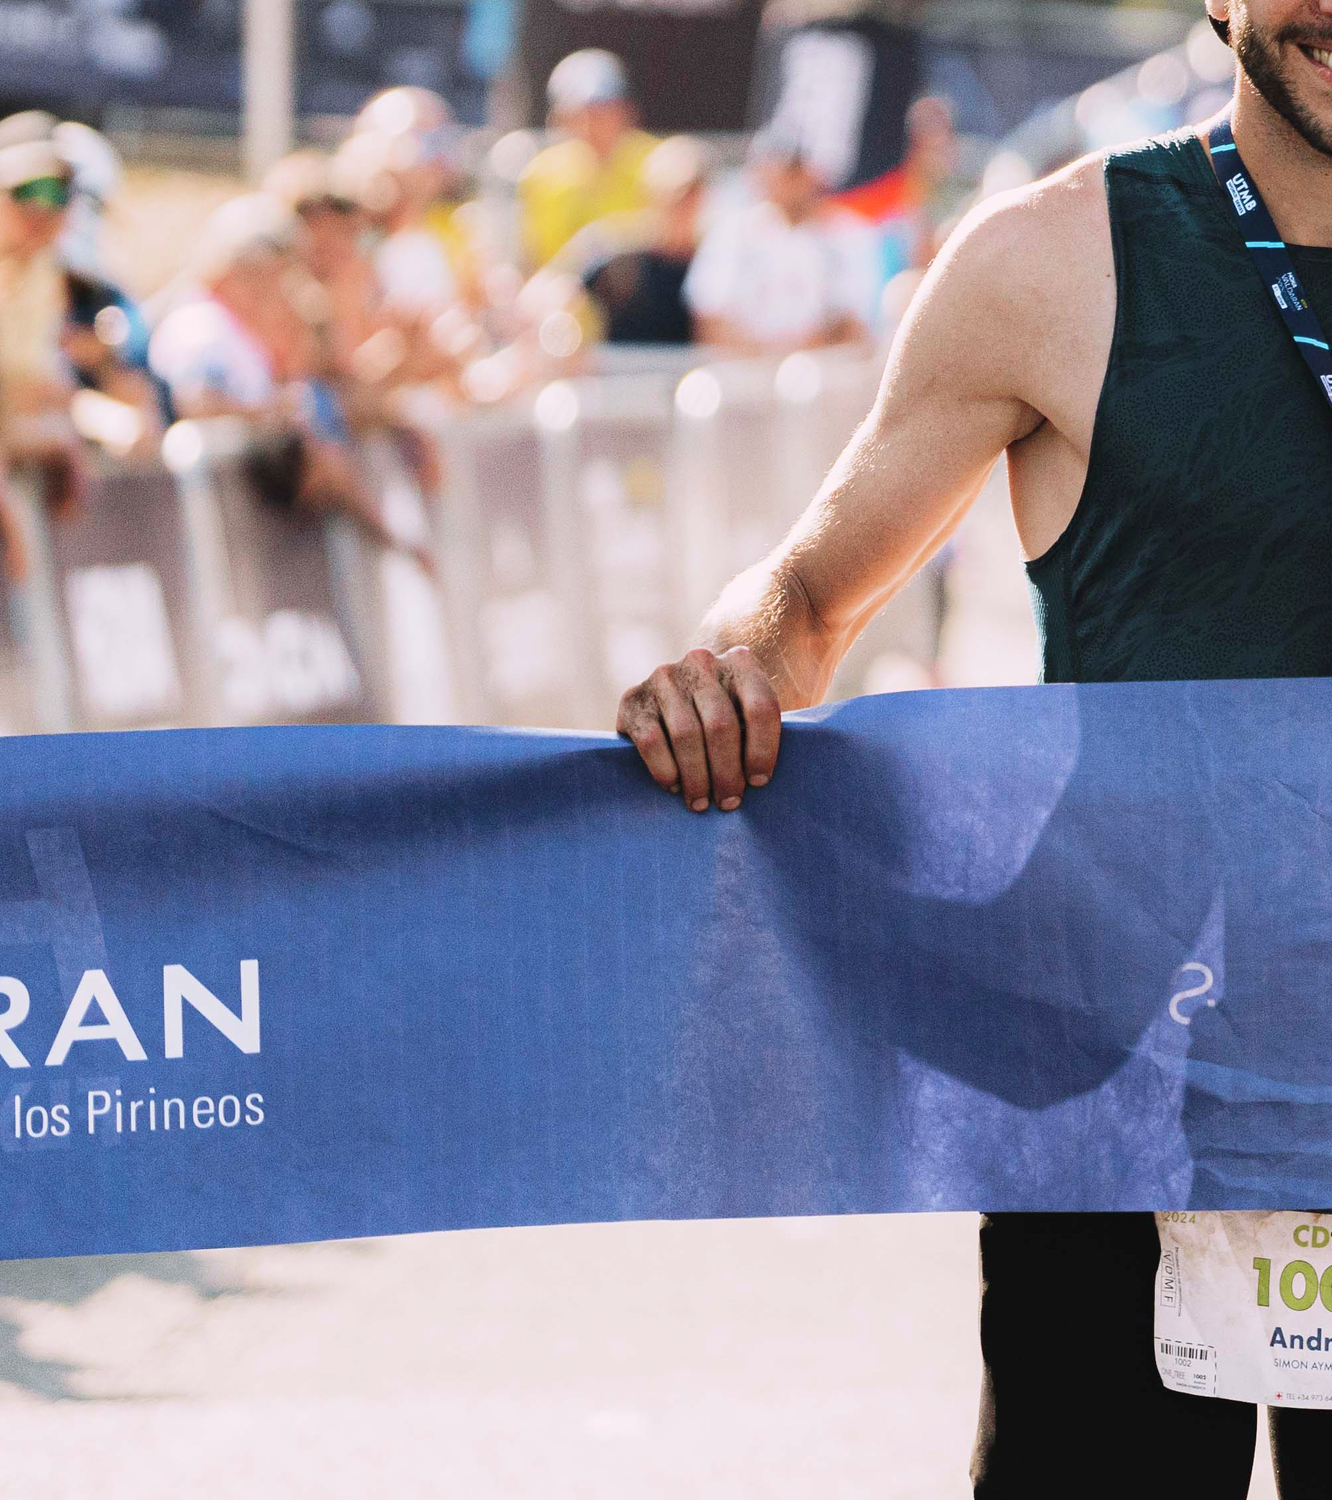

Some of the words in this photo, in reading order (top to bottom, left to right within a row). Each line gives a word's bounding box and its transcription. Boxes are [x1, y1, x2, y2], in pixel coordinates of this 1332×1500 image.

[1232, 172, 1257, 211] UTMB
[14, 1094, 70, 1138] los
[87, 1087, 265, 1134] Pirineos
[1174, 1357, 1192, 1368] 1002
[1273, 1357, 1308, 1370] SIMON
[1193, 1373, 1207, 1381] 1002
